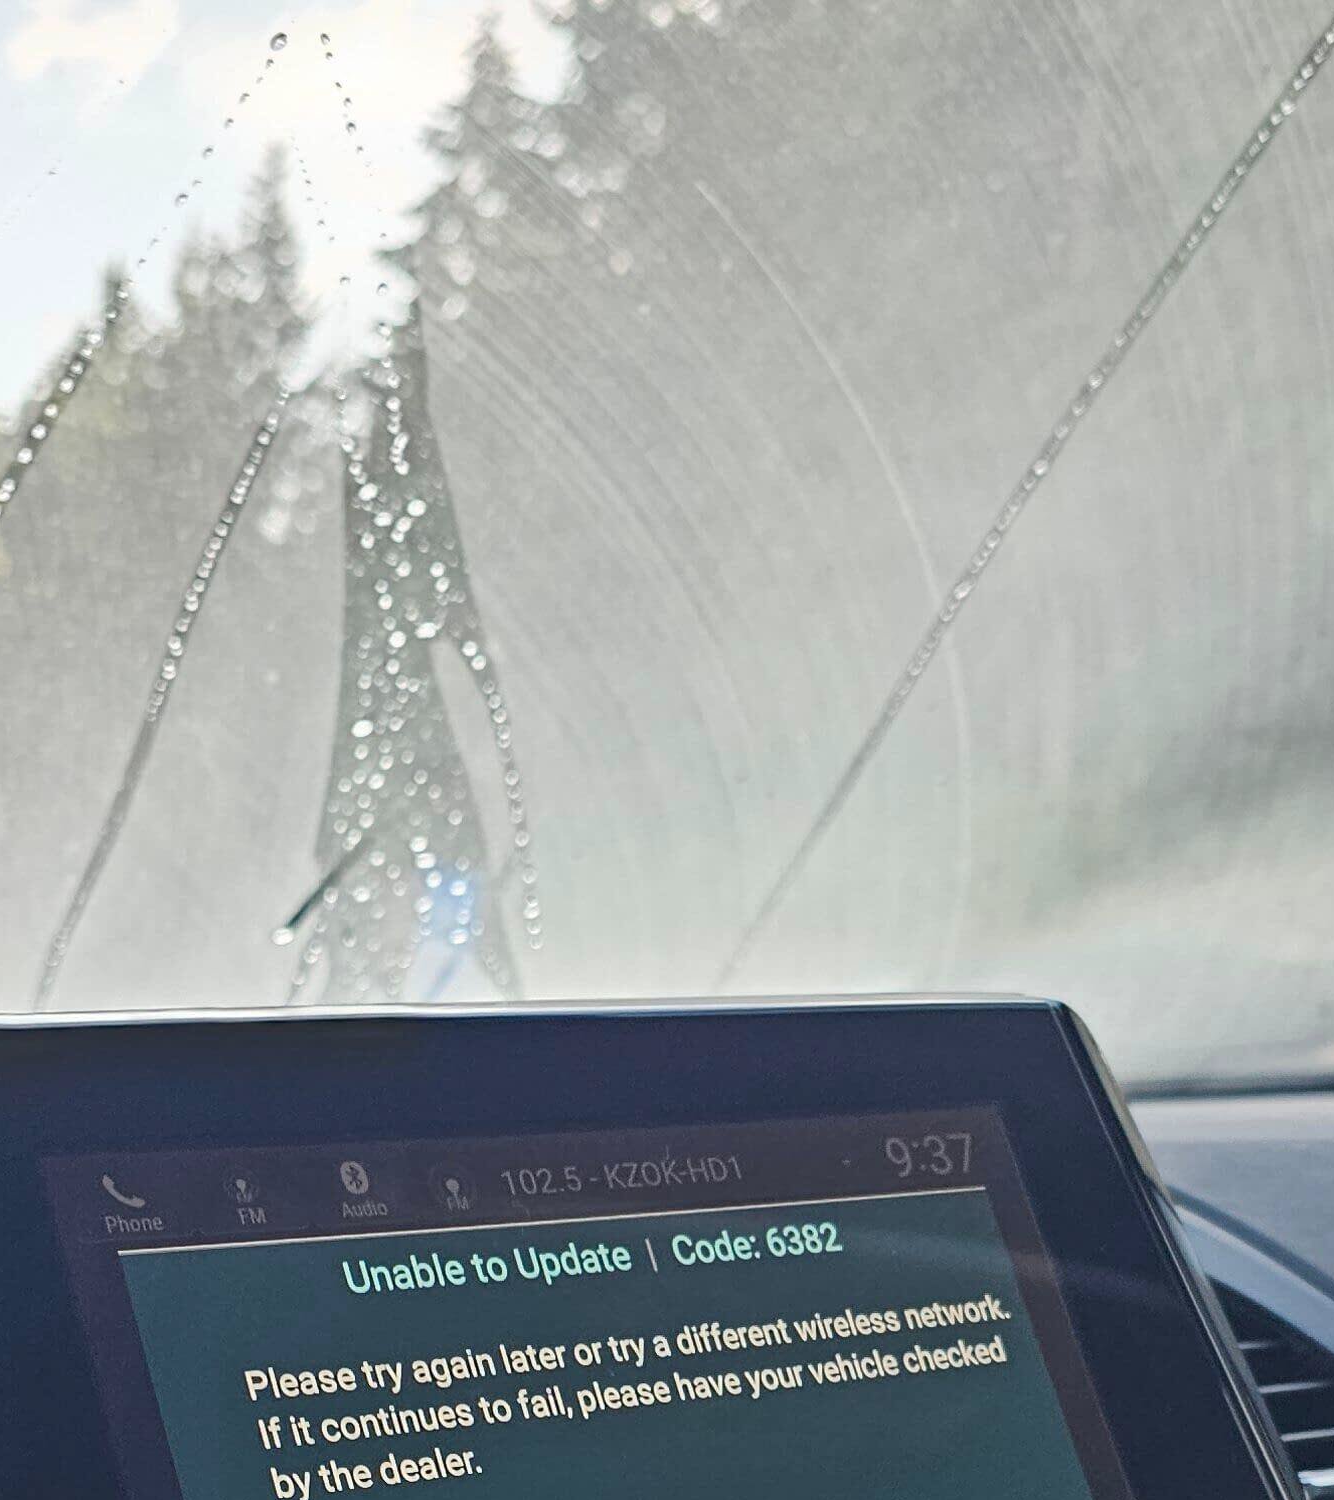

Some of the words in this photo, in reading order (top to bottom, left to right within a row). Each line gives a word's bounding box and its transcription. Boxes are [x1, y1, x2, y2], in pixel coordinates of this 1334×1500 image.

[501, 1166, 582, 1196] 102.5
[603, 1156, 742, 1191] KZOK-HD1
[885, 1132, 972, 1178] 9:37
[105, 1211, 164, 1234] Phone
[238, 1206, 267, 1226] FM
[342, 1201, 388, 1218] Audio
[341, 1253, 466, 1295] Unable
[470, 1254, 508, 1285] to
[514, 1242, 633, 1286] Update
[671, 1231, 761, 1266] Code:
[766, 1222, 843, 1255] 6382
[244, 1362, 357, 1402] Please
[361, 1358, 403, 1393] try
[412, 1349, 497, 1389] again
[499, 1343, 566, 1376] later
[574, 1341, 603, 1366] or
[607, 1335, 645, 1368] try
[653, 1336, 672, 1358] a
[674, 1319, 793, 1357] different
[794, 1306, 902, 1342] wireless
[905, 1294, 1011, 1331] network.
[258, 1419, 283, 1450] If
[291, 1416, 315, 1447] it
[321, 1404, 475, 1438] continues
[479, 1396, 512, 1425] to
[517, 1387, 575, 1420] fail,
[576, 1379, 672, 1420] please
[673, 1363, 742, 1402] have
[745, 1364, 803, 1399] your
[808, 1349, 899, 1387] vehicle
[903, 1335, 1007, 1375] checked
[317, 1459, 374, 1493] the
[379, 1448, 483, 1487] dealer.
